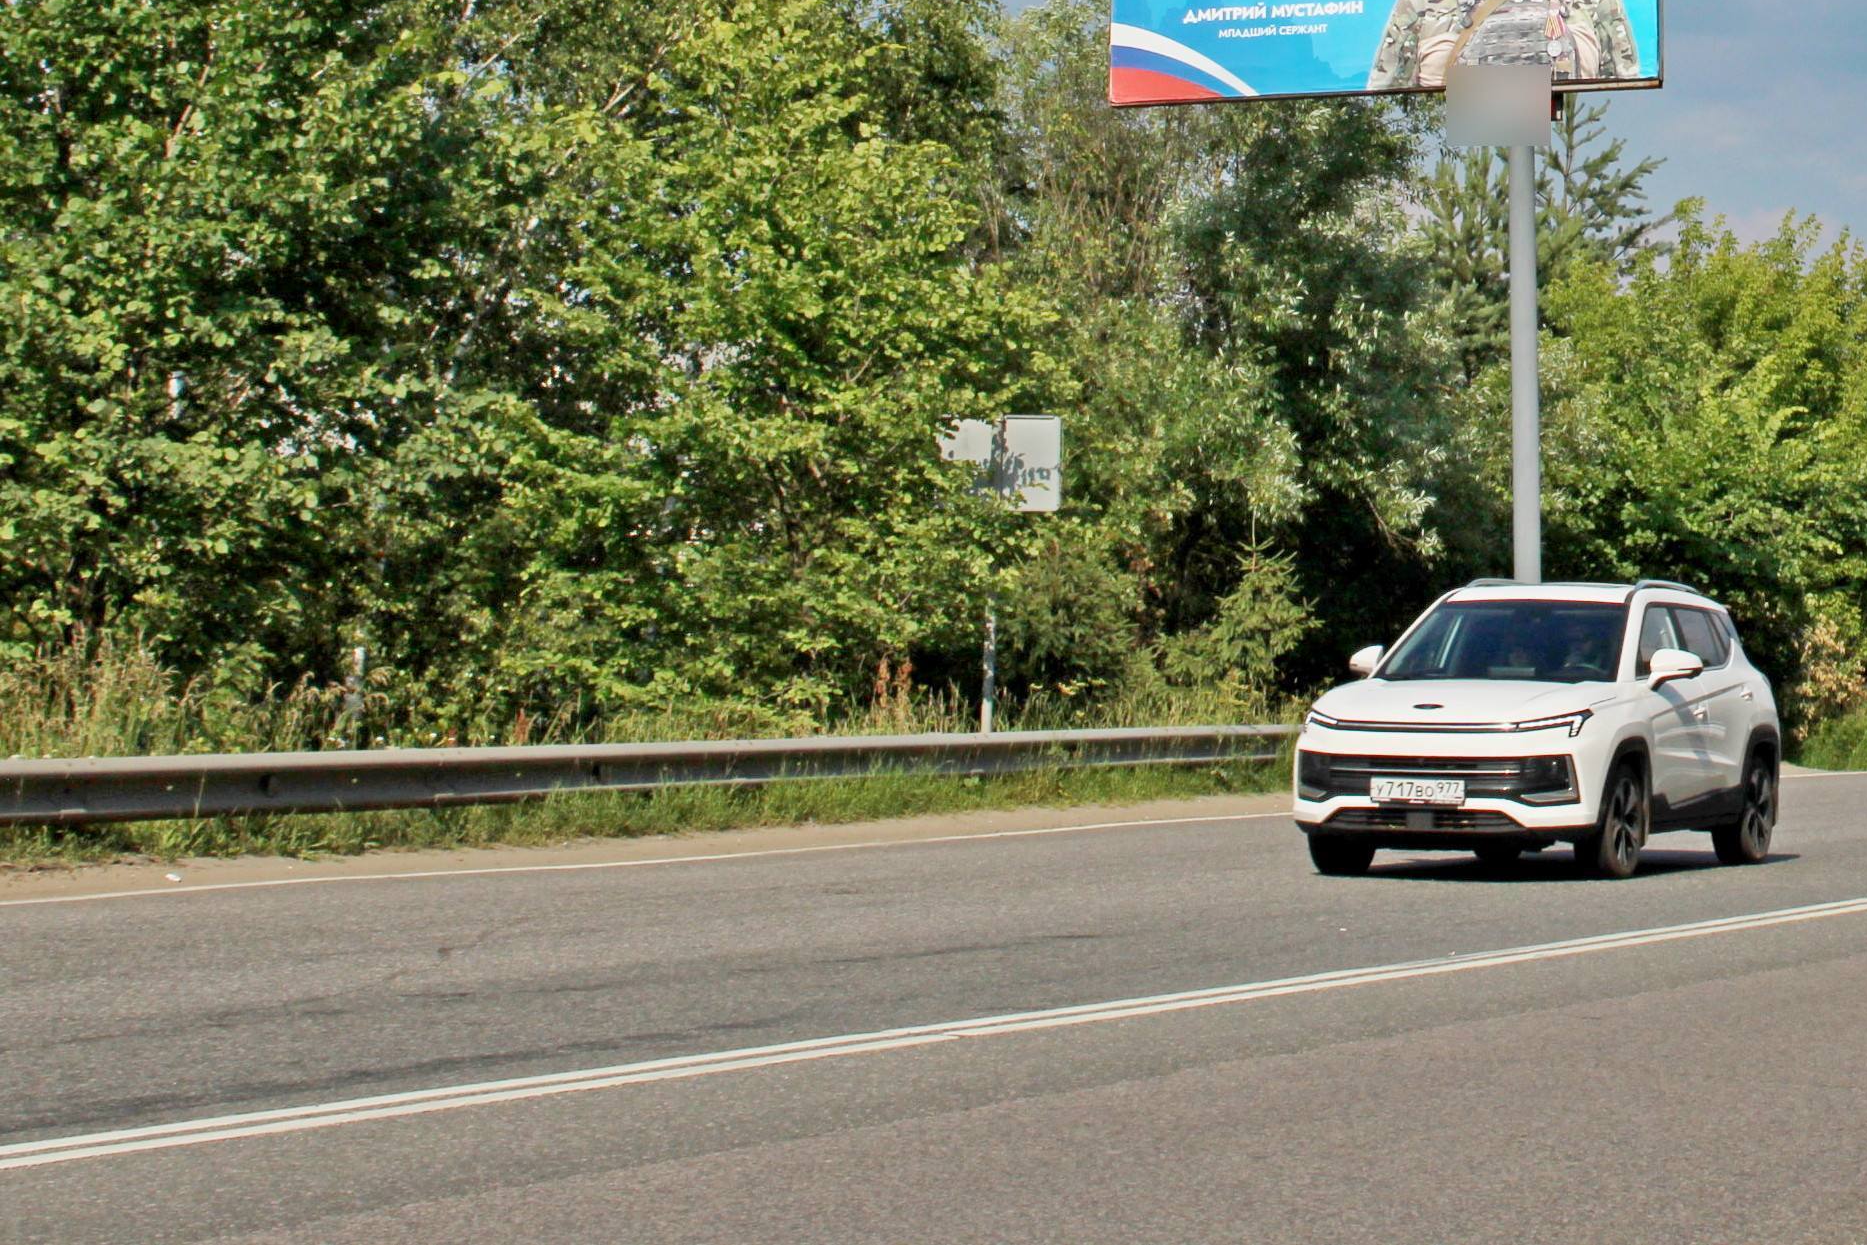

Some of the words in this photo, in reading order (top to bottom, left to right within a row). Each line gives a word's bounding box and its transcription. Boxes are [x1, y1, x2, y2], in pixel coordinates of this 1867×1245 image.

[1183, 2, 1267, 24] ДМИТРИЙ
[1271, 0, 1364, 19] МУСТАФИН
[1218, 24, 1277, 39] МЛАДШИЙ
[1279, 23, 1328, 36] СЕРЖАНТ
